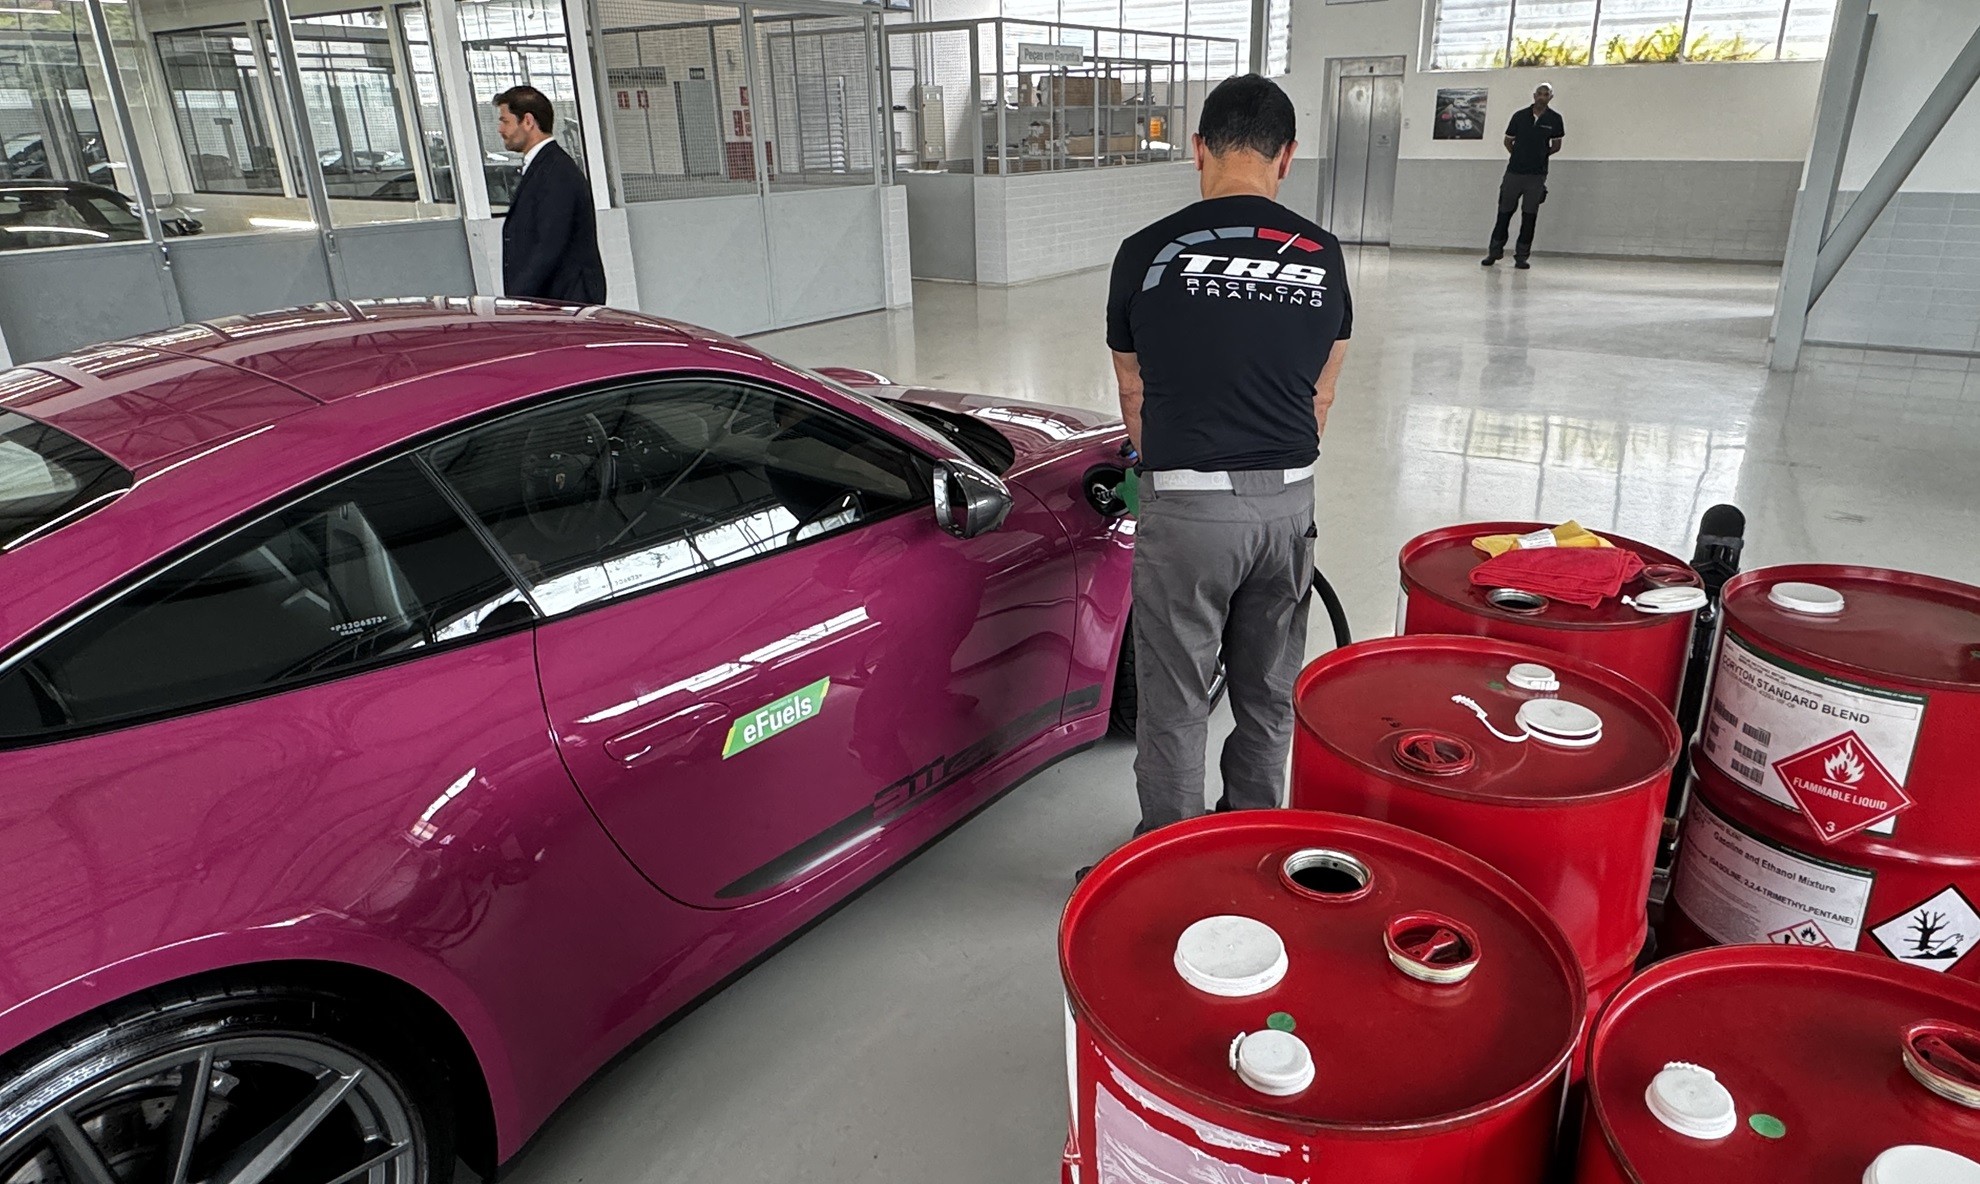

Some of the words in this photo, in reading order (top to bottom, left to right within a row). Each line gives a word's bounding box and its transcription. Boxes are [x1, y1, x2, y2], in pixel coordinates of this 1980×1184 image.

[1179, 254, 1327, 285] TRS
[1186, 278, 1257, 292] RACE
[1275, 285, 1322, 299] CAR
[1186, 287, 1323, 308] TRAINING
[1722, 654, 1756, 684] CORYTON
[1756, 678, 1819, 710] STANDARD
[1821, 704, 1870, 724] BLEND
[743, 695, 813, 744] eFuels
[1792, 776, 1851, 803] FLAMMABLE
[1852, 794, 1888, 811] LIQUID
[1825, 821, 1836, 832] 3
[1713, 831, 1744, 856] Gasoline
[1744, 852, 1760, 865] and
[1761, 859, 1796, 881] Ethanol
[1798, 874, 1836, 894] Mixture
